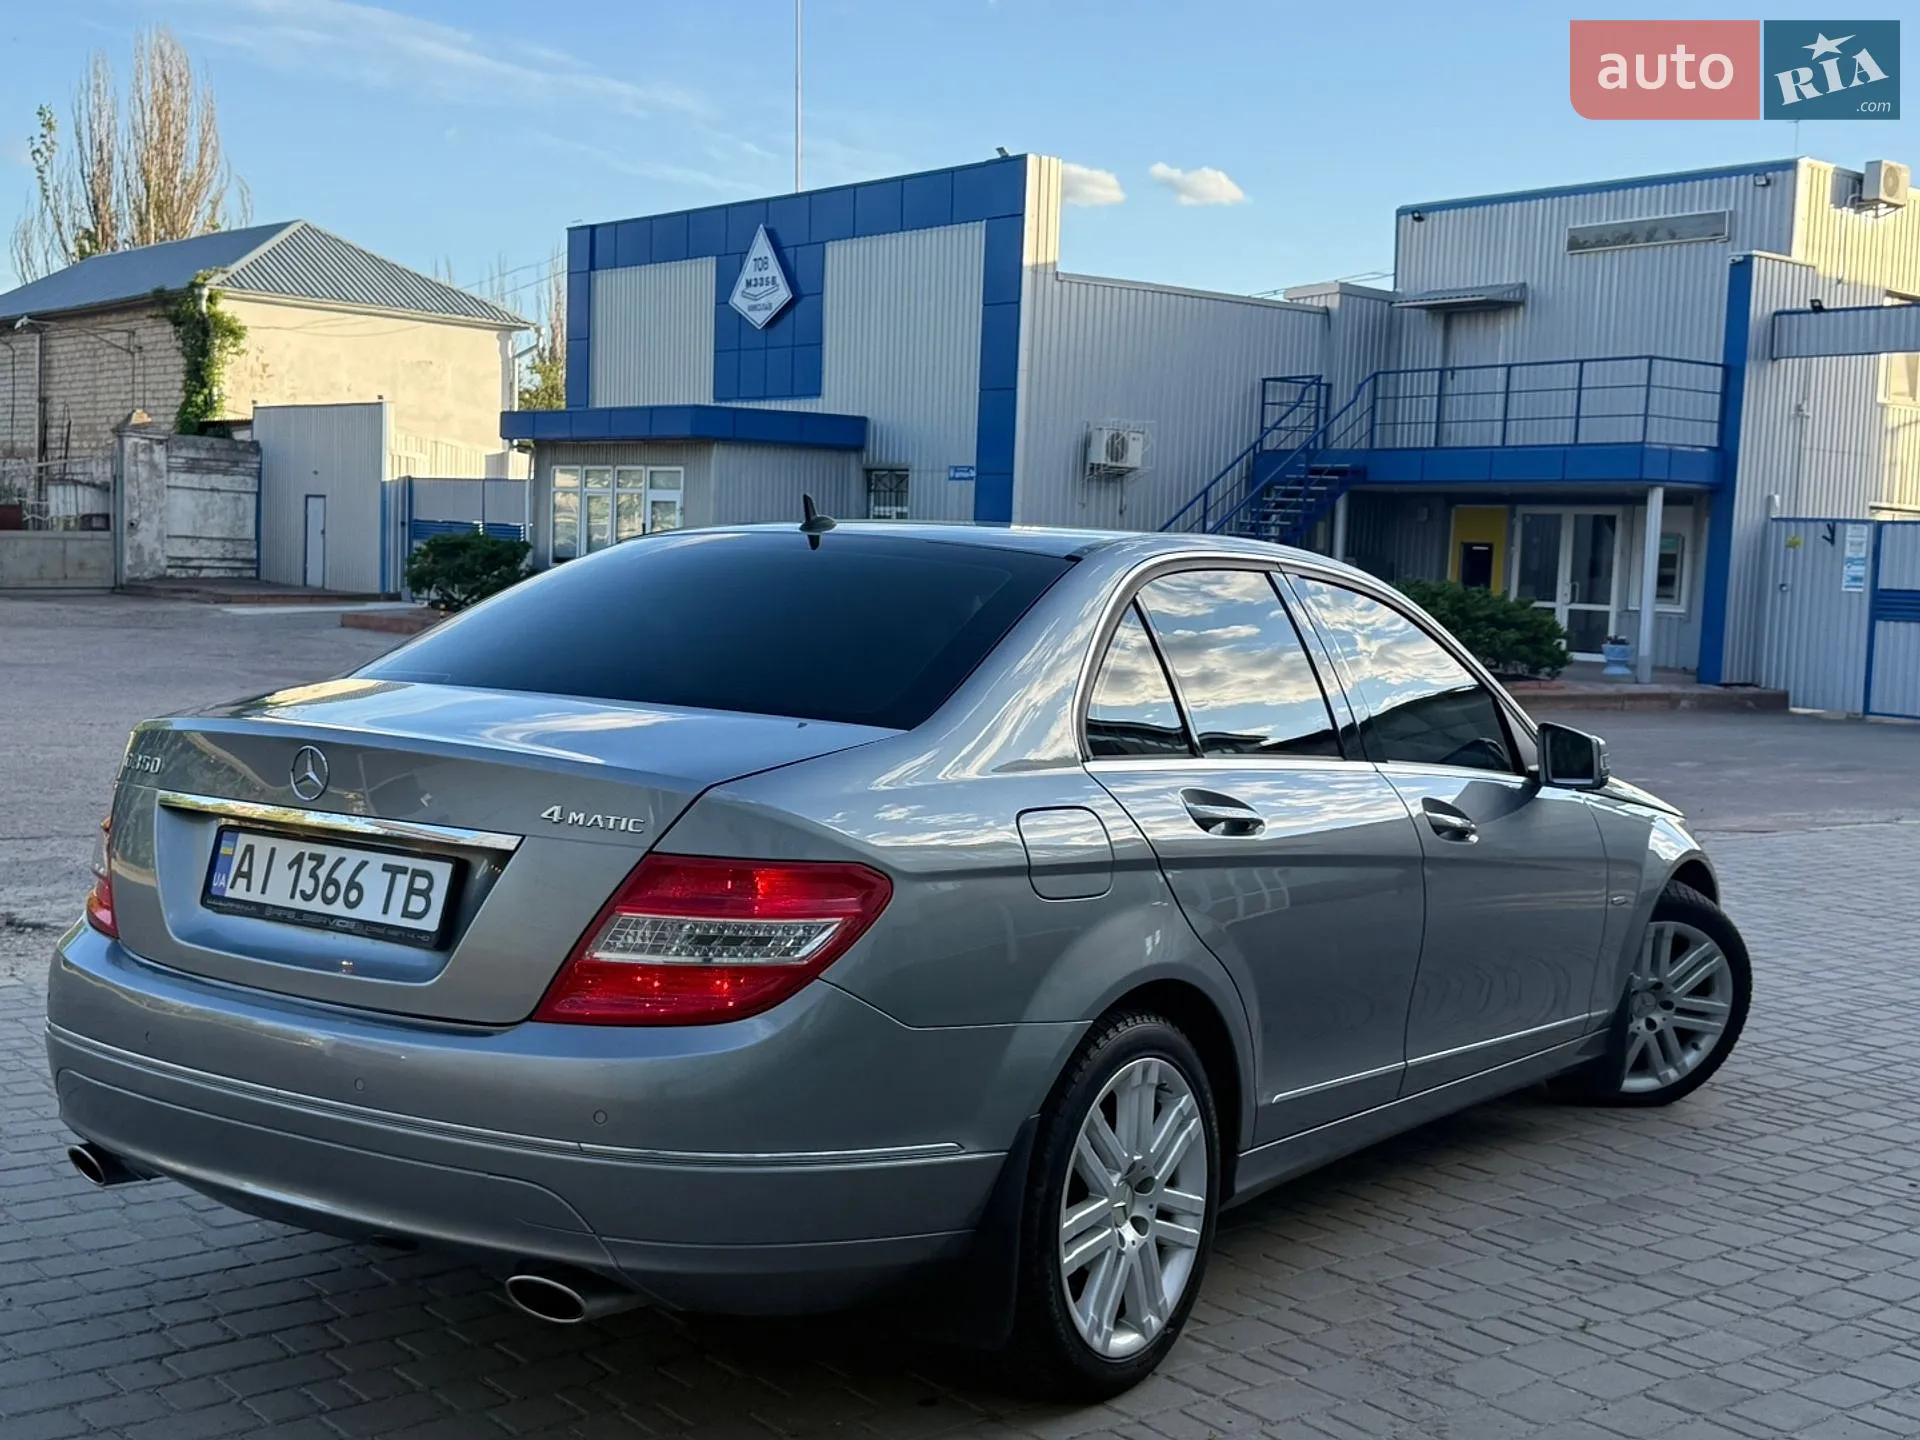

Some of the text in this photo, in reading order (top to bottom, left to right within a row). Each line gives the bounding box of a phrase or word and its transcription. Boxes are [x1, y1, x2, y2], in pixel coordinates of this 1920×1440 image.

[213, 875, 226, 887] UA
[229, 844, 276, 895] AI
[287, 851, 370, 910] 1366
[382, 862, 435, 920] TB
